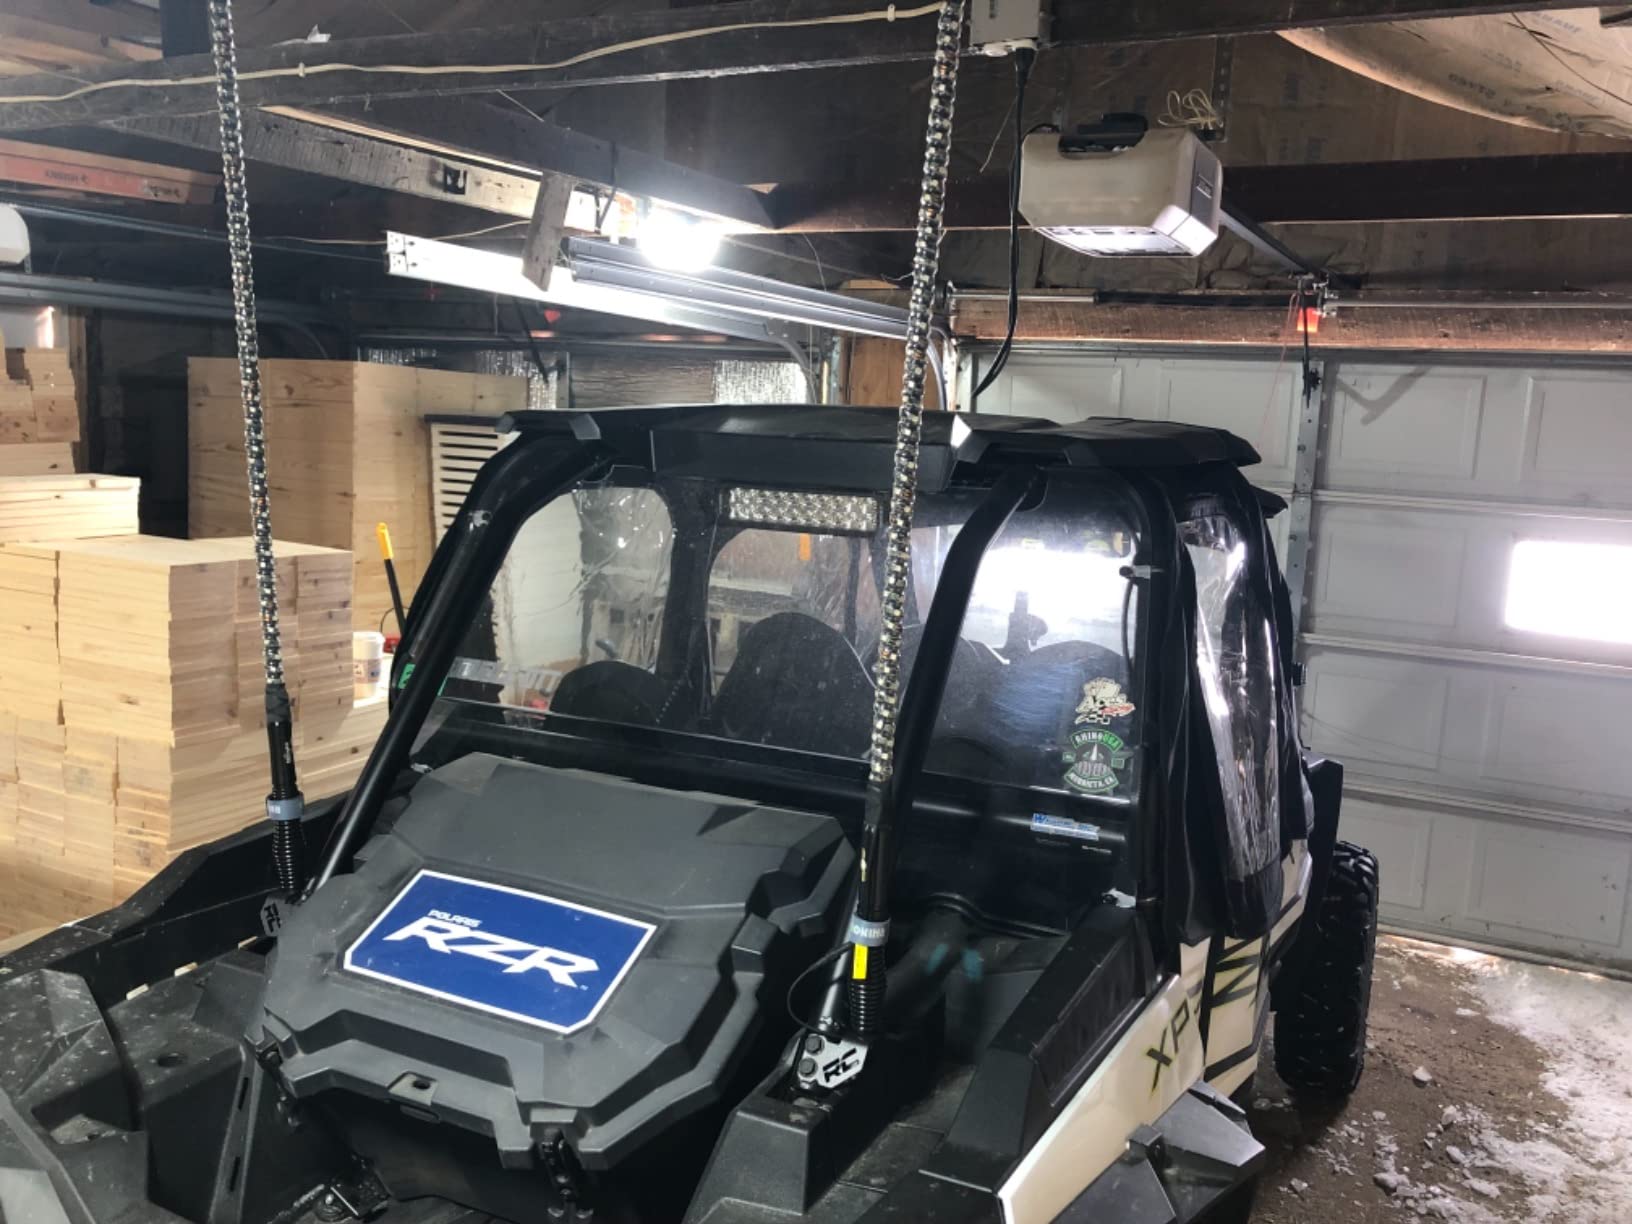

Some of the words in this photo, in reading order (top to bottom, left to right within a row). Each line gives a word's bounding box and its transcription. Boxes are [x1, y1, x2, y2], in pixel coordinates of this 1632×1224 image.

[427, 908, 483, 928] POLARIS
[382, 915, 600, 989] RZR
[822, 1047, 860, 1083] RC
[1146, 996, 1190, 1093] XP
